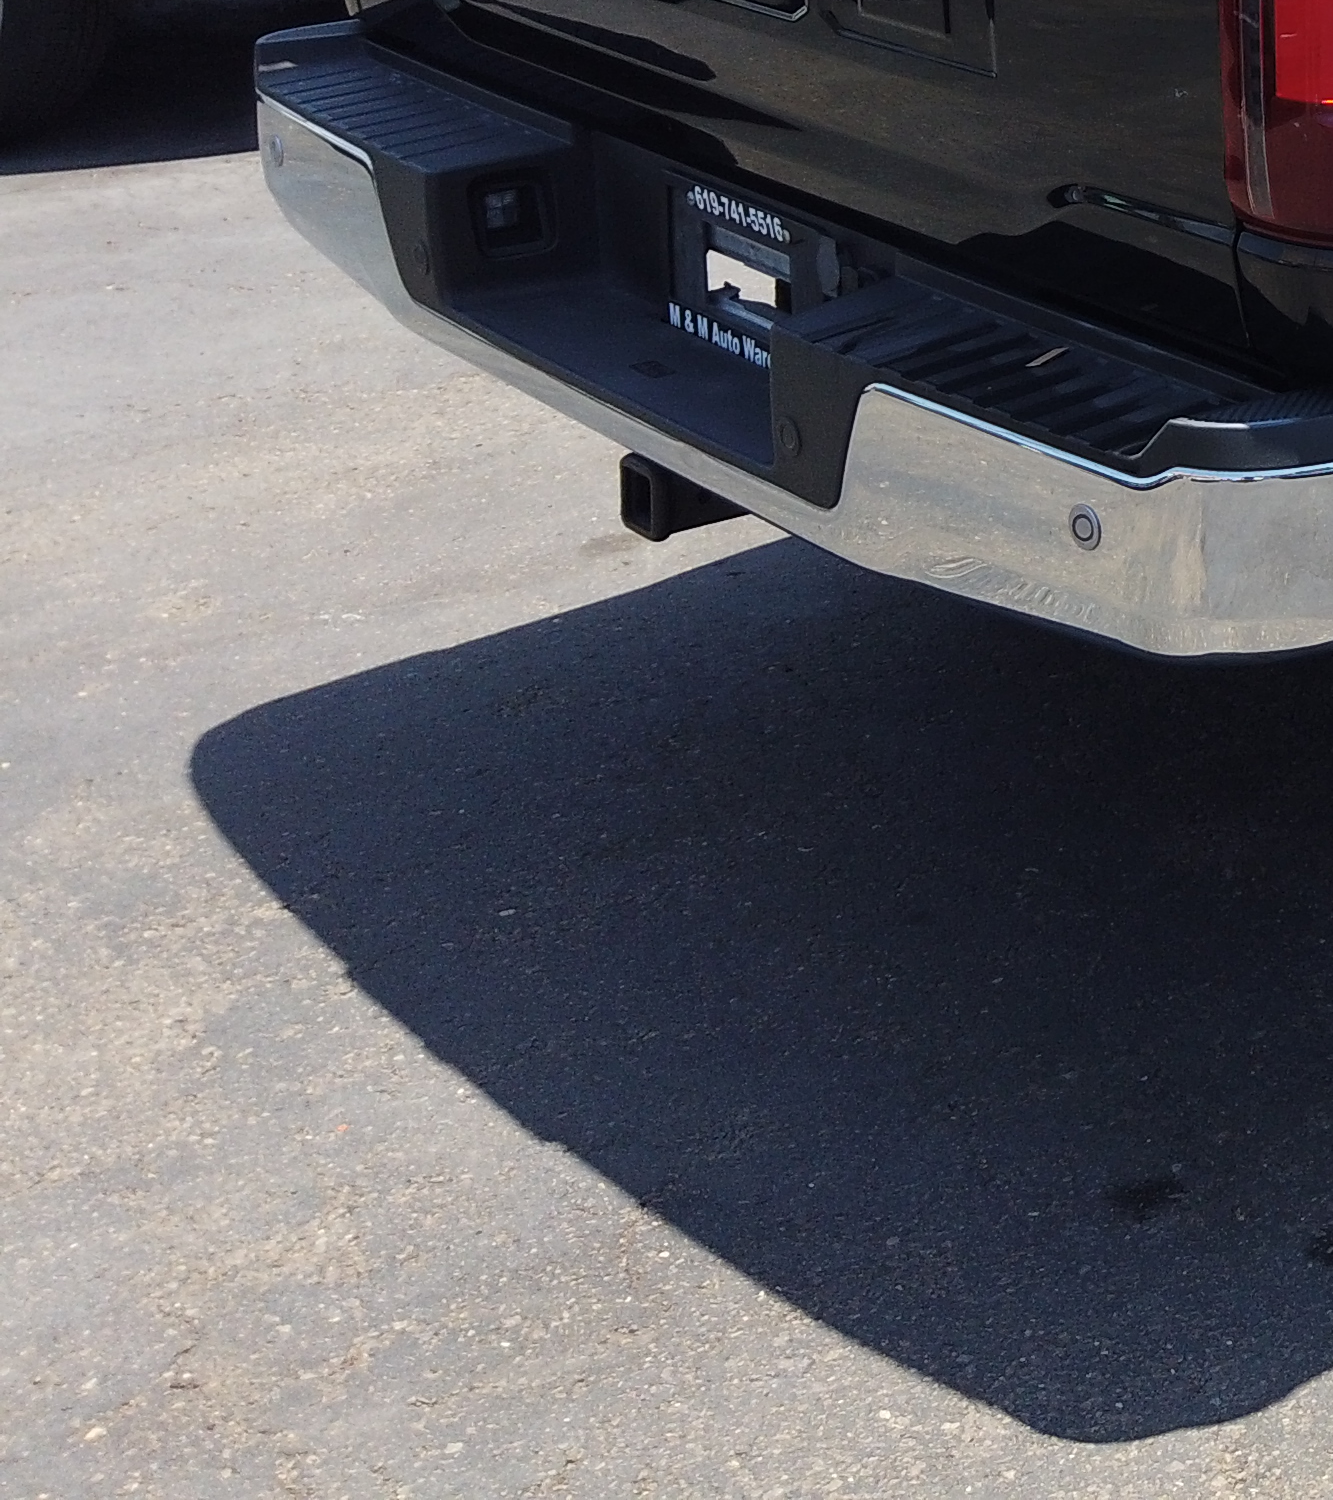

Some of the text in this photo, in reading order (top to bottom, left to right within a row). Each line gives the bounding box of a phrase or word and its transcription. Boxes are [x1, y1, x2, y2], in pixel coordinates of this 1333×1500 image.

[693, 185, 784, 242] 619-741-5516
[668, 302, 681, 329] M
[683, 309, 695, 334] &
[696, 314, 709, 341] M
[712, 322, 741, 356] Auto
